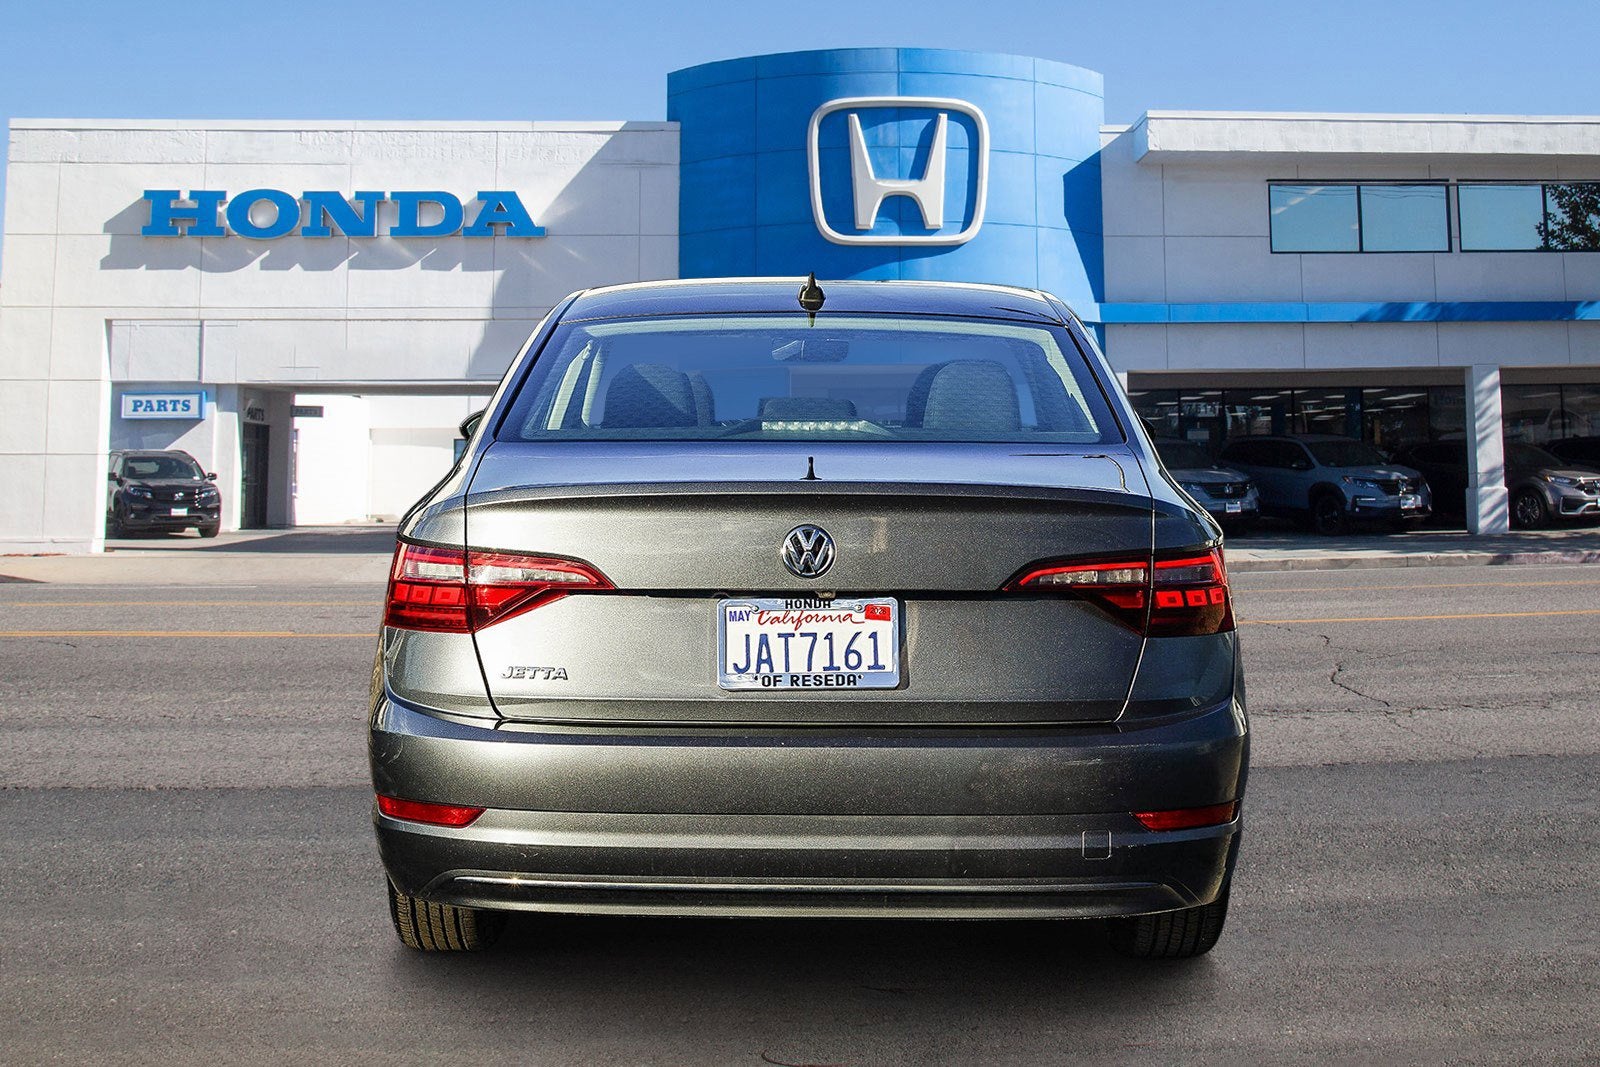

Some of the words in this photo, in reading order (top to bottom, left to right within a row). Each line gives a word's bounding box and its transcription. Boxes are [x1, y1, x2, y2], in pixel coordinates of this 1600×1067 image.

[141, 188, 547, 240] HONDA
[131, 399, 191, 413] PARTS
[785, 600, 832, 609] HONDA
[728, 610, 751, 622] MAY
[757, 609, 865, 631] California
[733, 631, 886, 674] JAT7161
[501, 665, 569, 681] JETTA
[761, 675, 783, 687] OF
[790, 674, 858, 687] RESEDA
